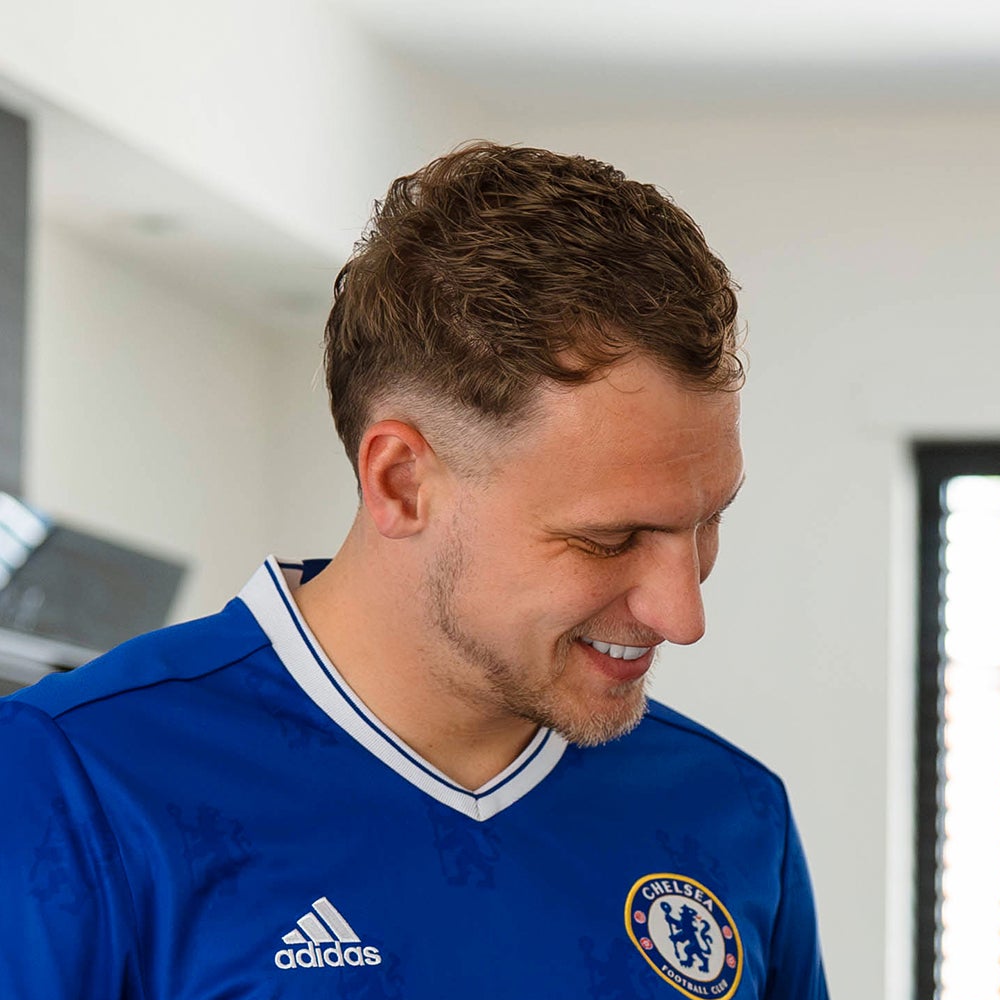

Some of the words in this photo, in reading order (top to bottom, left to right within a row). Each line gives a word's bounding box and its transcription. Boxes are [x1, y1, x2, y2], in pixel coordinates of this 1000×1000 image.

[642, 880, 714, 913] CHELSEA
[274, 940, 382, 970] adidas
[661, 964, 709, 995] FOOTBALL
